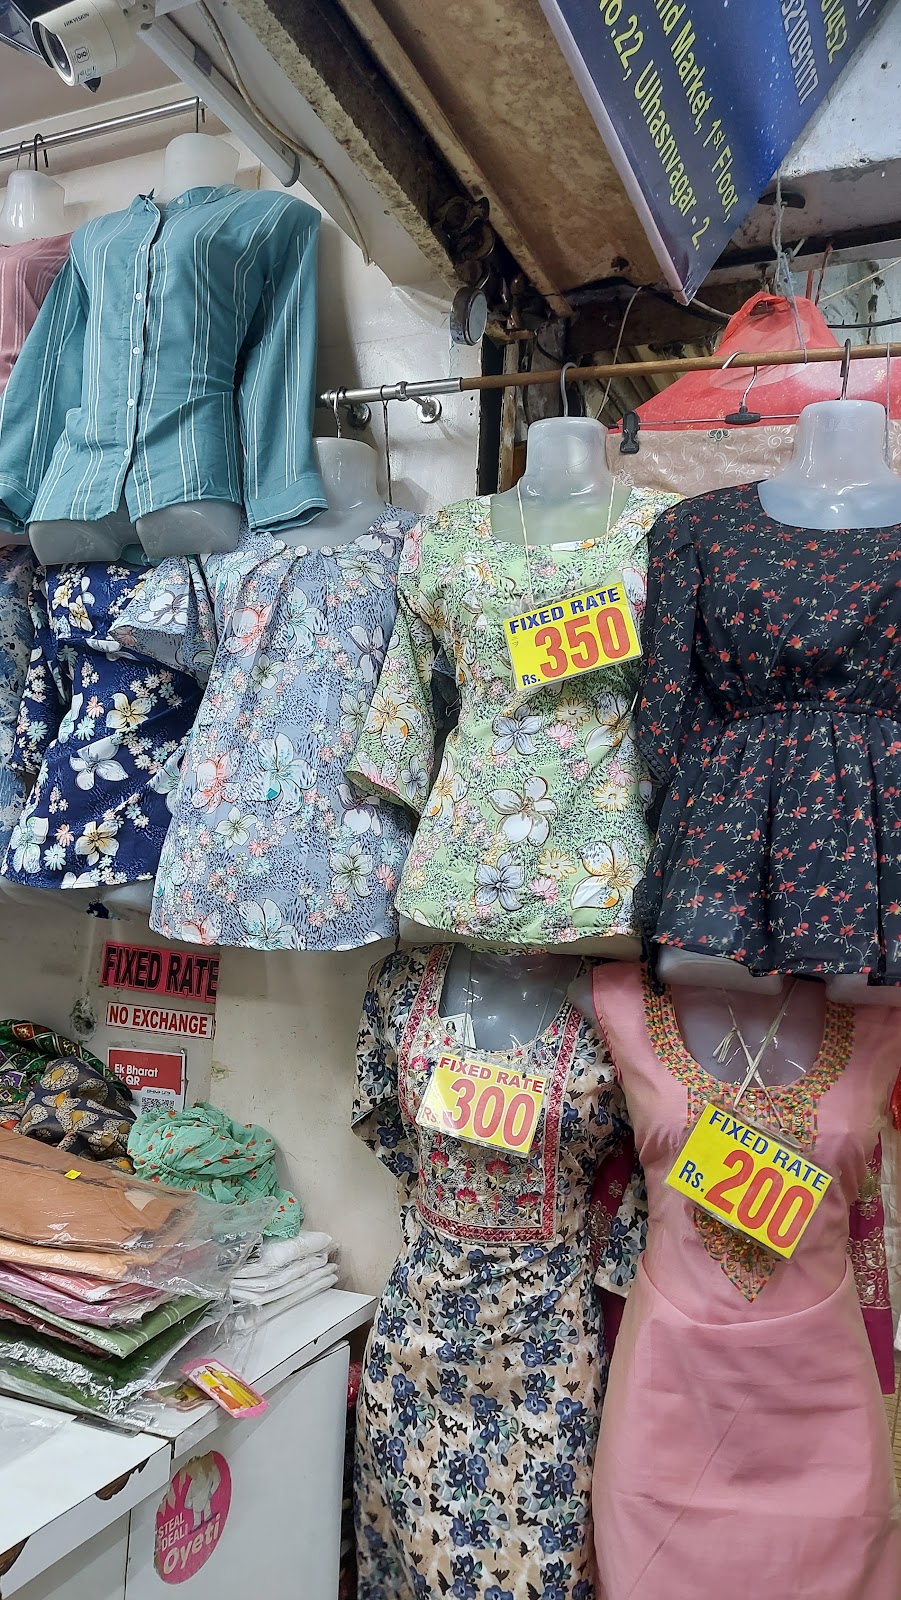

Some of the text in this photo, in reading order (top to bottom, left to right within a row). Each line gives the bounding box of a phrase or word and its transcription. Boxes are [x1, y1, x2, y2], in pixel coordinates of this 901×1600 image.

[64, 12, 90, 27] HIKVISION
[670, 19, 713, 135] Market,
[711, 144, 738, 224] Floor,
[509, 587, 621, 635] FIXED RATE
[521, 607, 631, 686] Rs. 350
[102, 946, 220, 999] FIXED RATE
[109, 1005, 208, 1035] NO EXCHANGE
[114, 1063, 159, 1078] Ek Bharat
[125, 1075, 141, 1086] QR
[439, 1057, 544, 1094] FIXED RATE
[442, 1078, 535, 1147] 300
[708, 1110, 829, 1192] FIXED RATE
[678, 1149, 815, 1249] Rs. 200
[158, 1511, 185, 1539] STEAL
[163, 1512, 220, 1575] Oyeti
